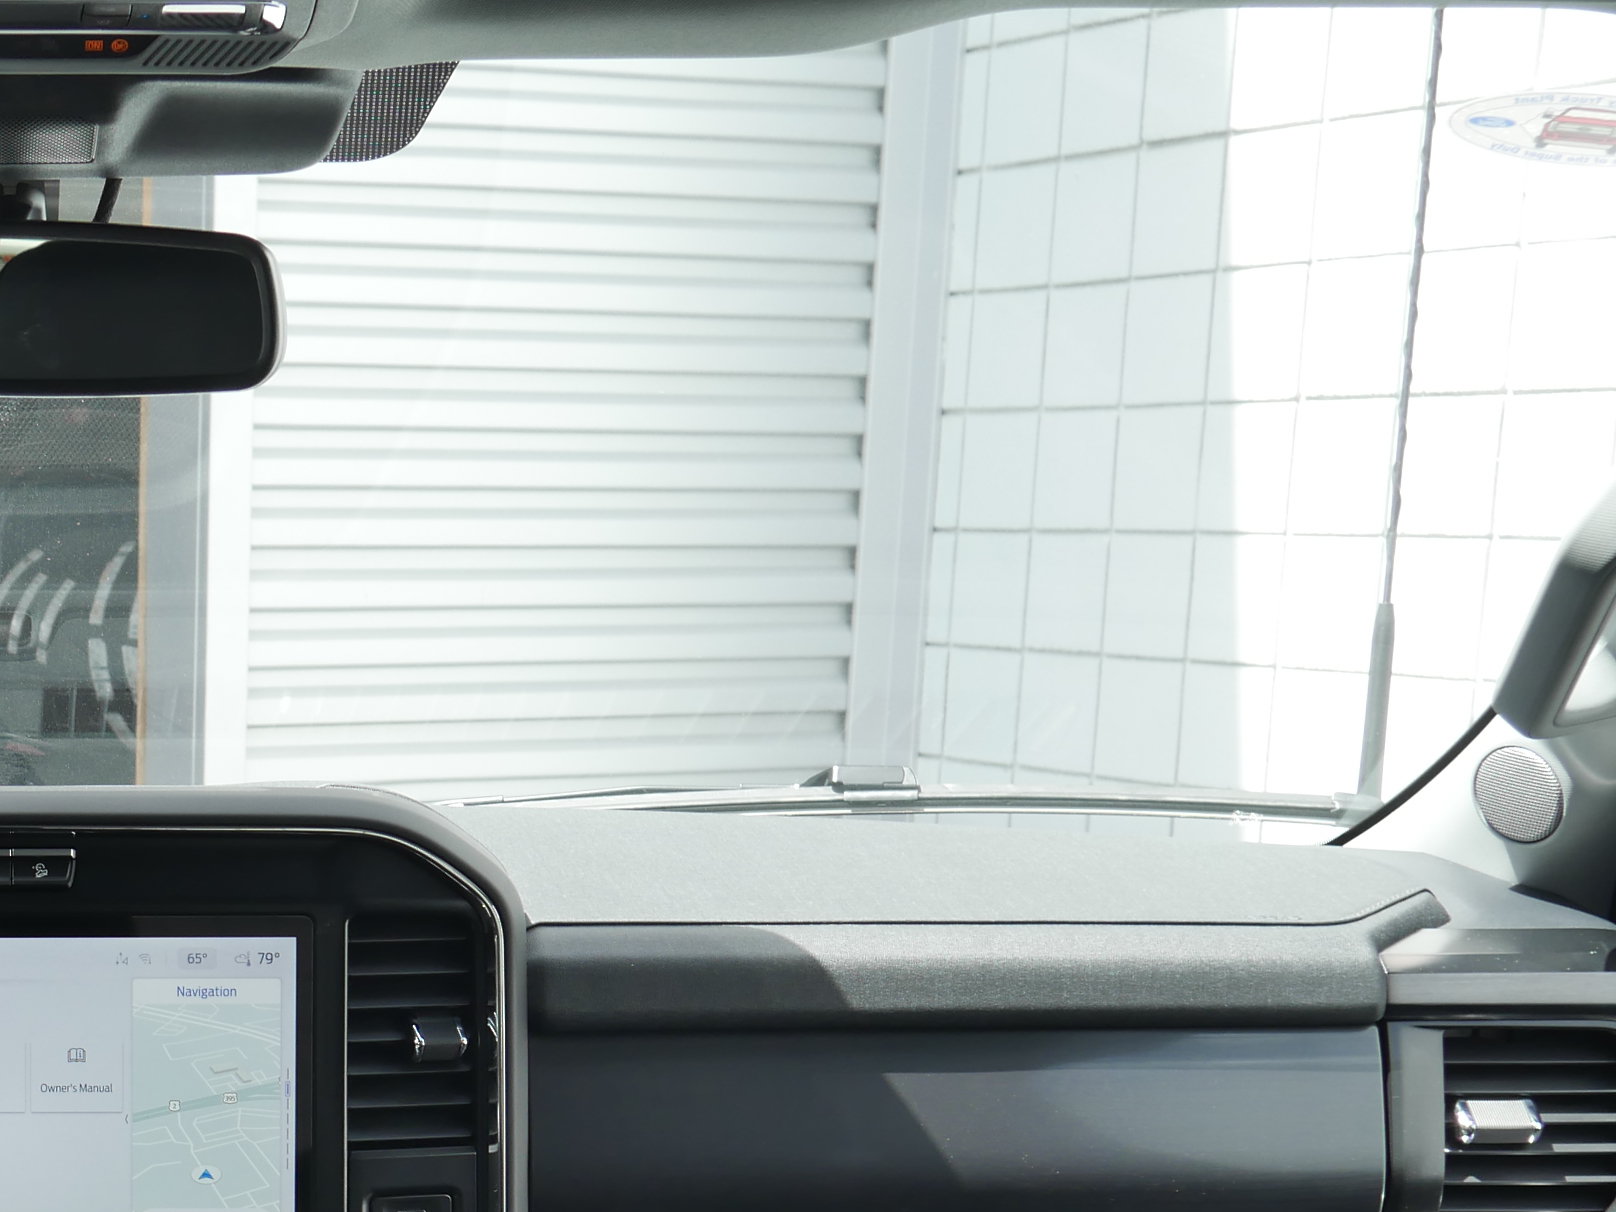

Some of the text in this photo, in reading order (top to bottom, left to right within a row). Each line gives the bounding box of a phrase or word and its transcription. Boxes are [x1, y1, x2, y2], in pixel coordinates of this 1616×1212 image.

[186, 952, 208, 965] 65°
[257, 951, 281, 965] 79°
[176, 985, 237, 999] Navigation
[40, 1082, 113, 1094] Owner's Manual
[171, 1102, 177, 1110] 2
